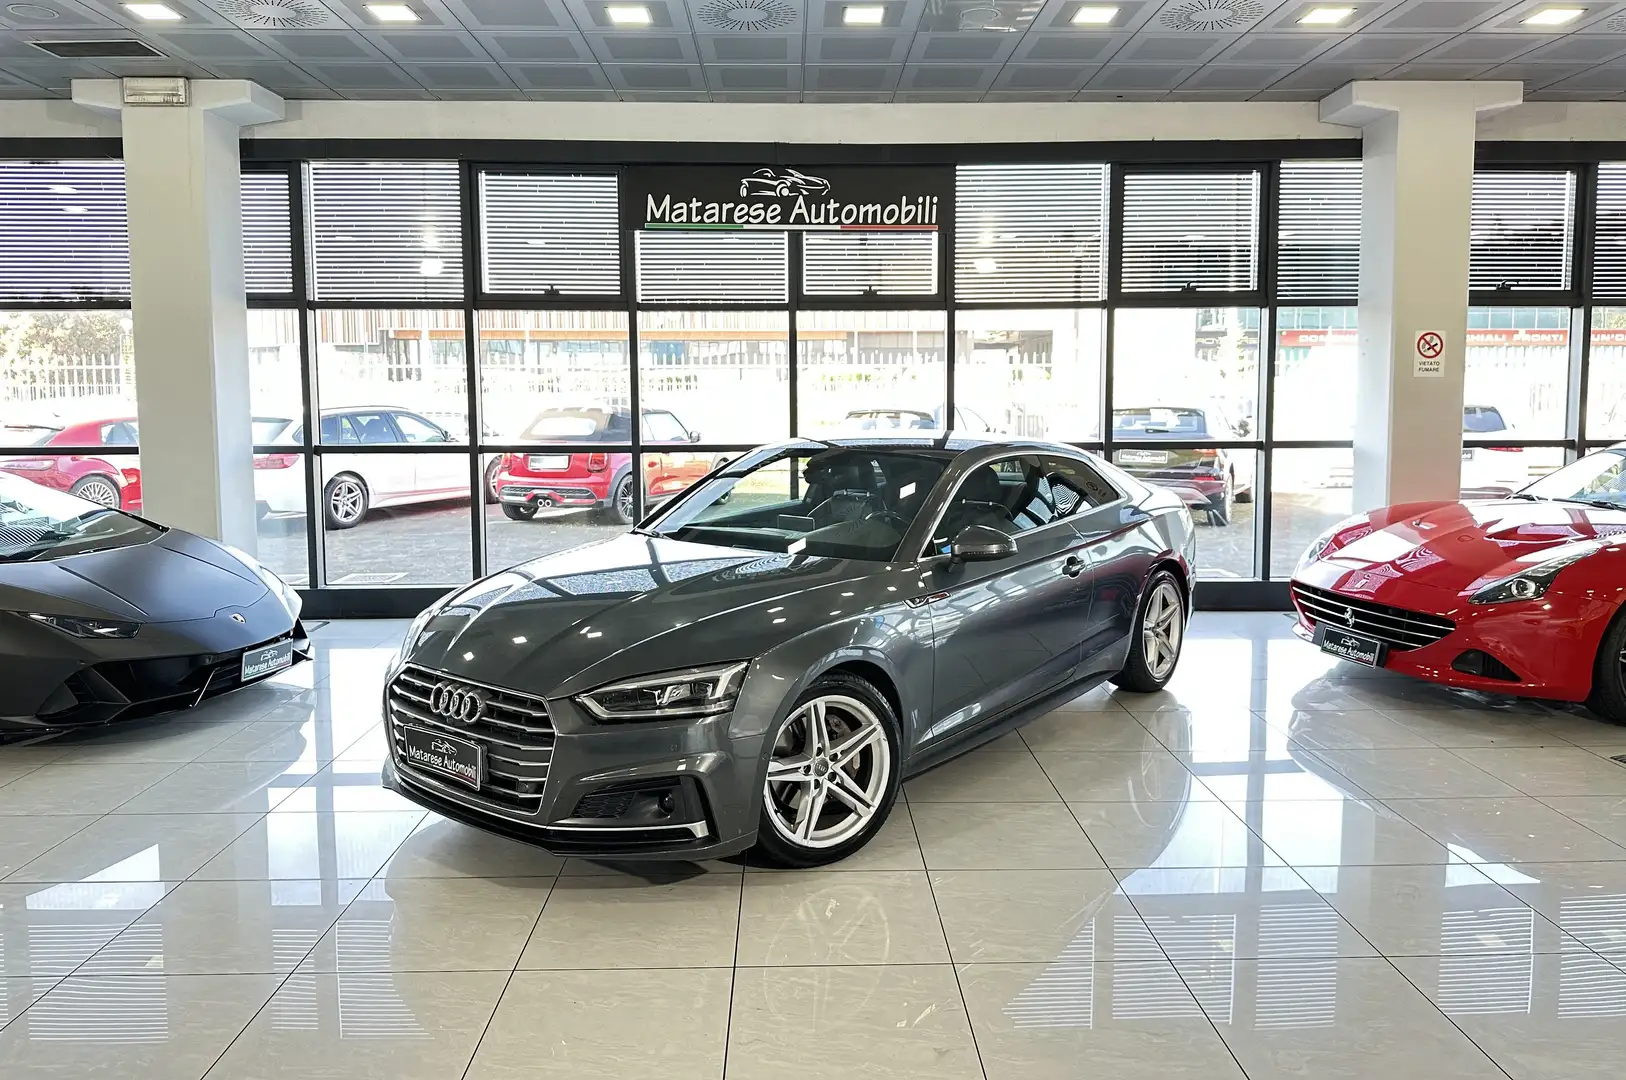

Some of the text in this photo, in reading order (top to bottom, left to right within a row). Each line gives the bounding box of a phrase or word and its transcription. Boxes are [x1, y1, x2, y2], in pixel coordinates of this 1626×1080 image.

[646, 193, 938, 224] Matarese Automobili
[1323, 639, 1348, 655] Matarese
[409, 745, 477, 779] Matarese Automobili
